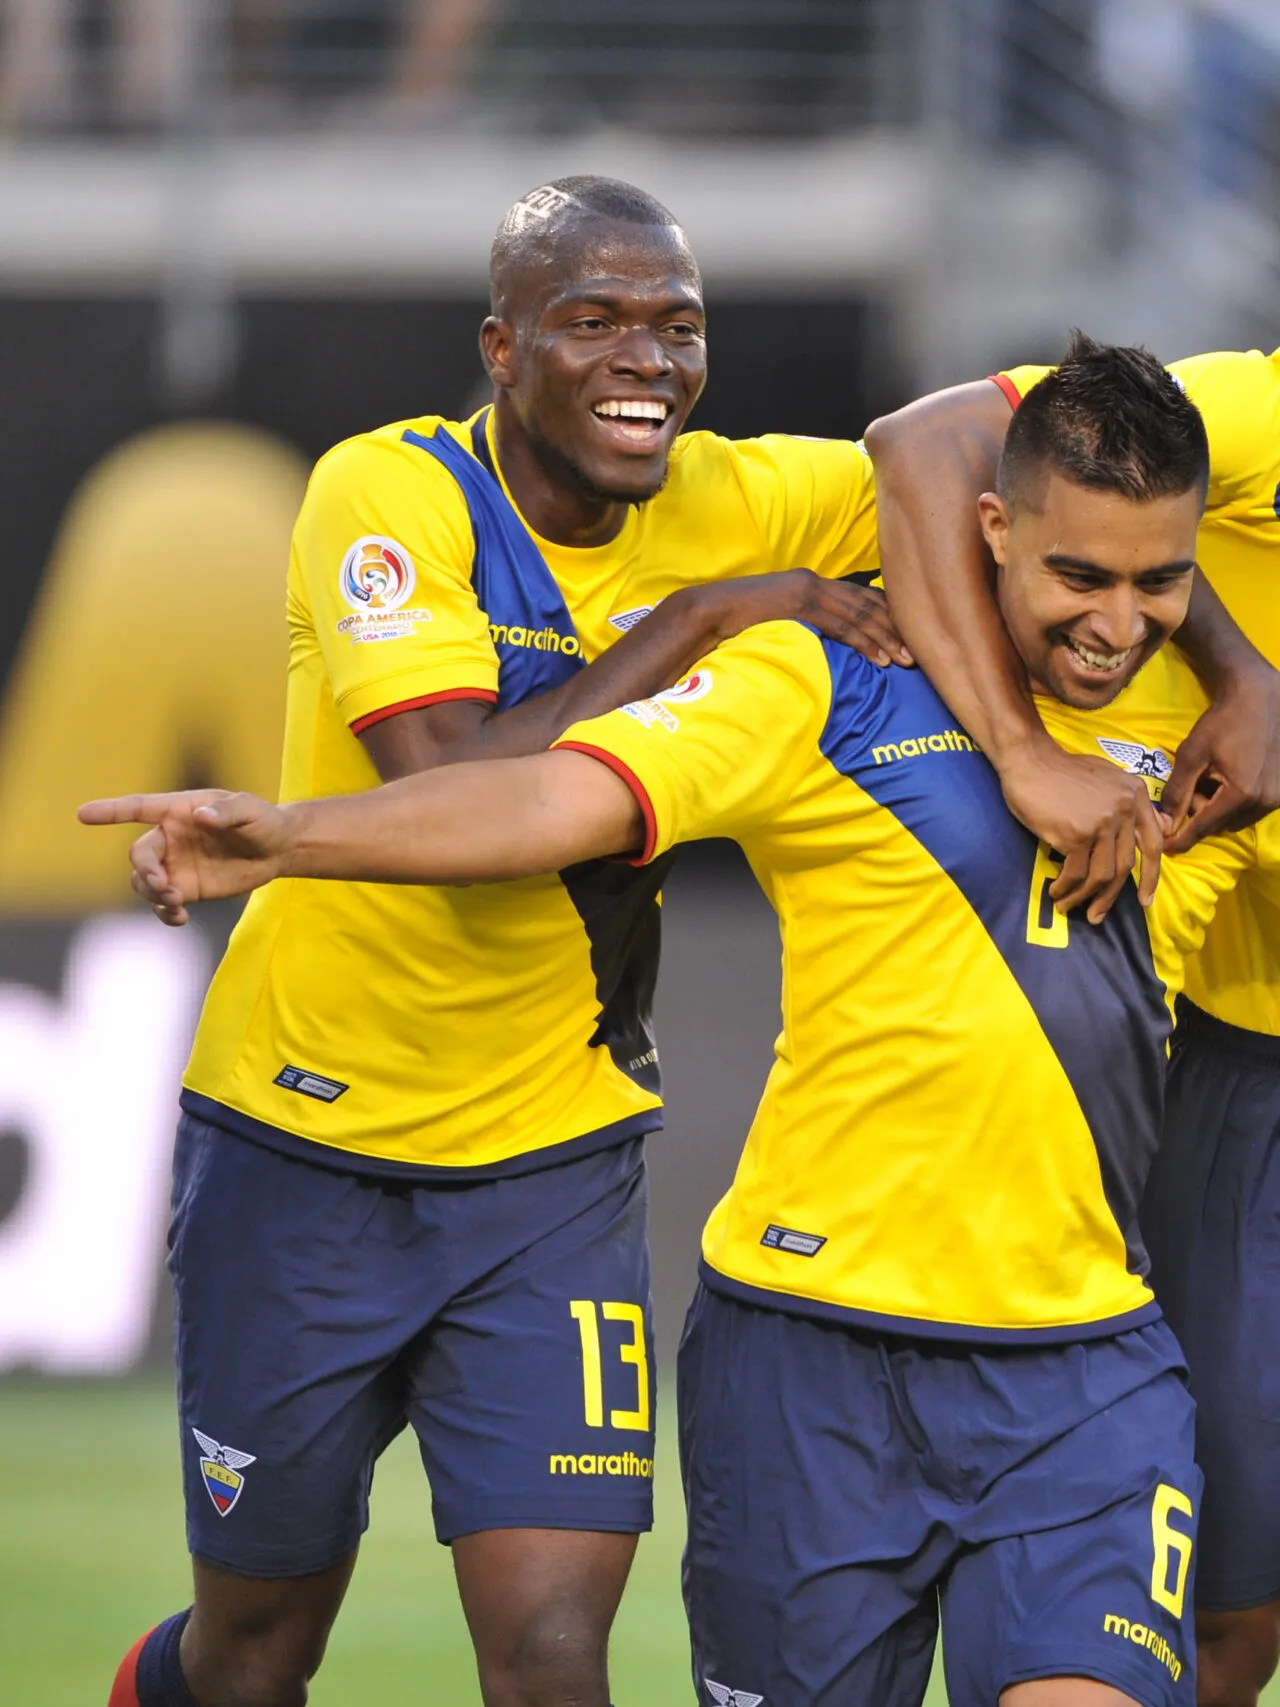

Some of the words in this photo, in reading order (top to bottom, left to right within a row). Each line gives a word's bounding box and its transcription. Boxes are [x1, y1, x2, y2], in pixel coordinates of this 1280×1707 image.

[337, 614, 363, 632] COPA
[367, 610, 430, 623] AMERICA
[872, 730, 980, 765] marath
[570, 1300, 649, 1432] 13
[1151, 1483, 1193, 1620] 6
[1104, 1614, 1182, 1682] marathon
